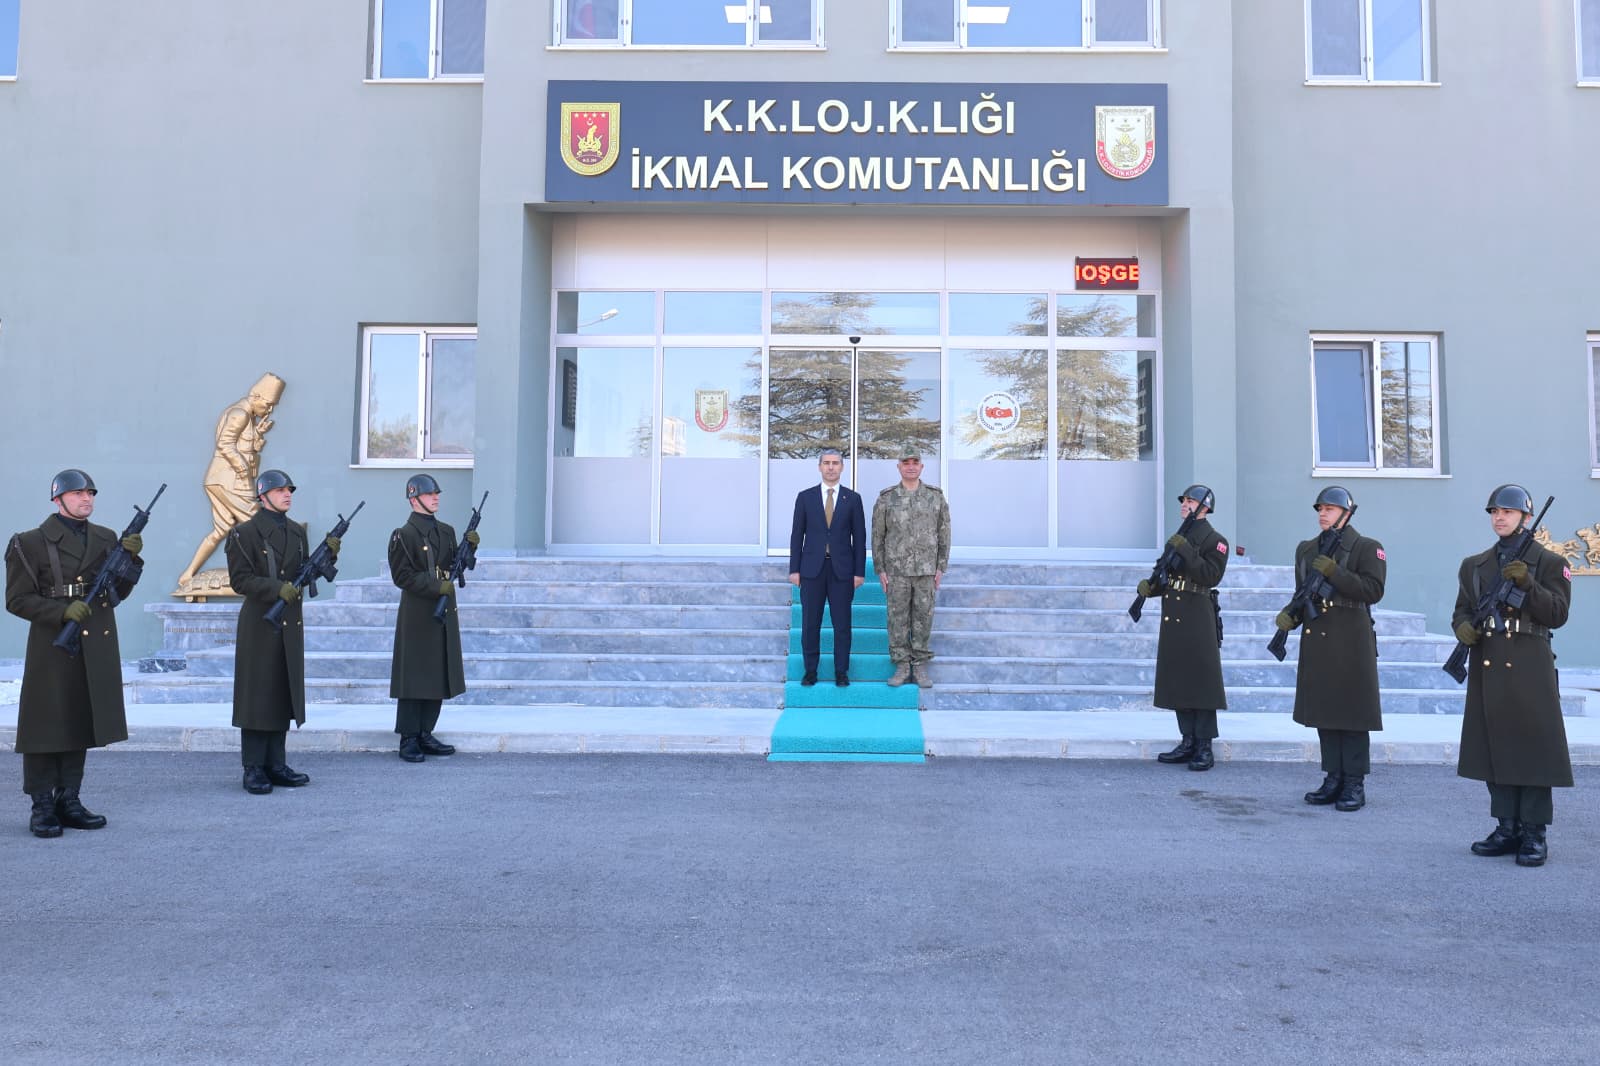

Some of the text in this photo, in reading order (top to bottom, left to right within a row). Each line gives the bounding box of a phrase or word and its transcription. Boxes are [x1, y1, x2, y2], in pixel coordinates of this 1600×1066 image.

[703, 92, 1016, 134] K.K.LOJ.K.LIĞI
[631, 147, 1087, 192] İKMAL KOMUTANLIĞI
